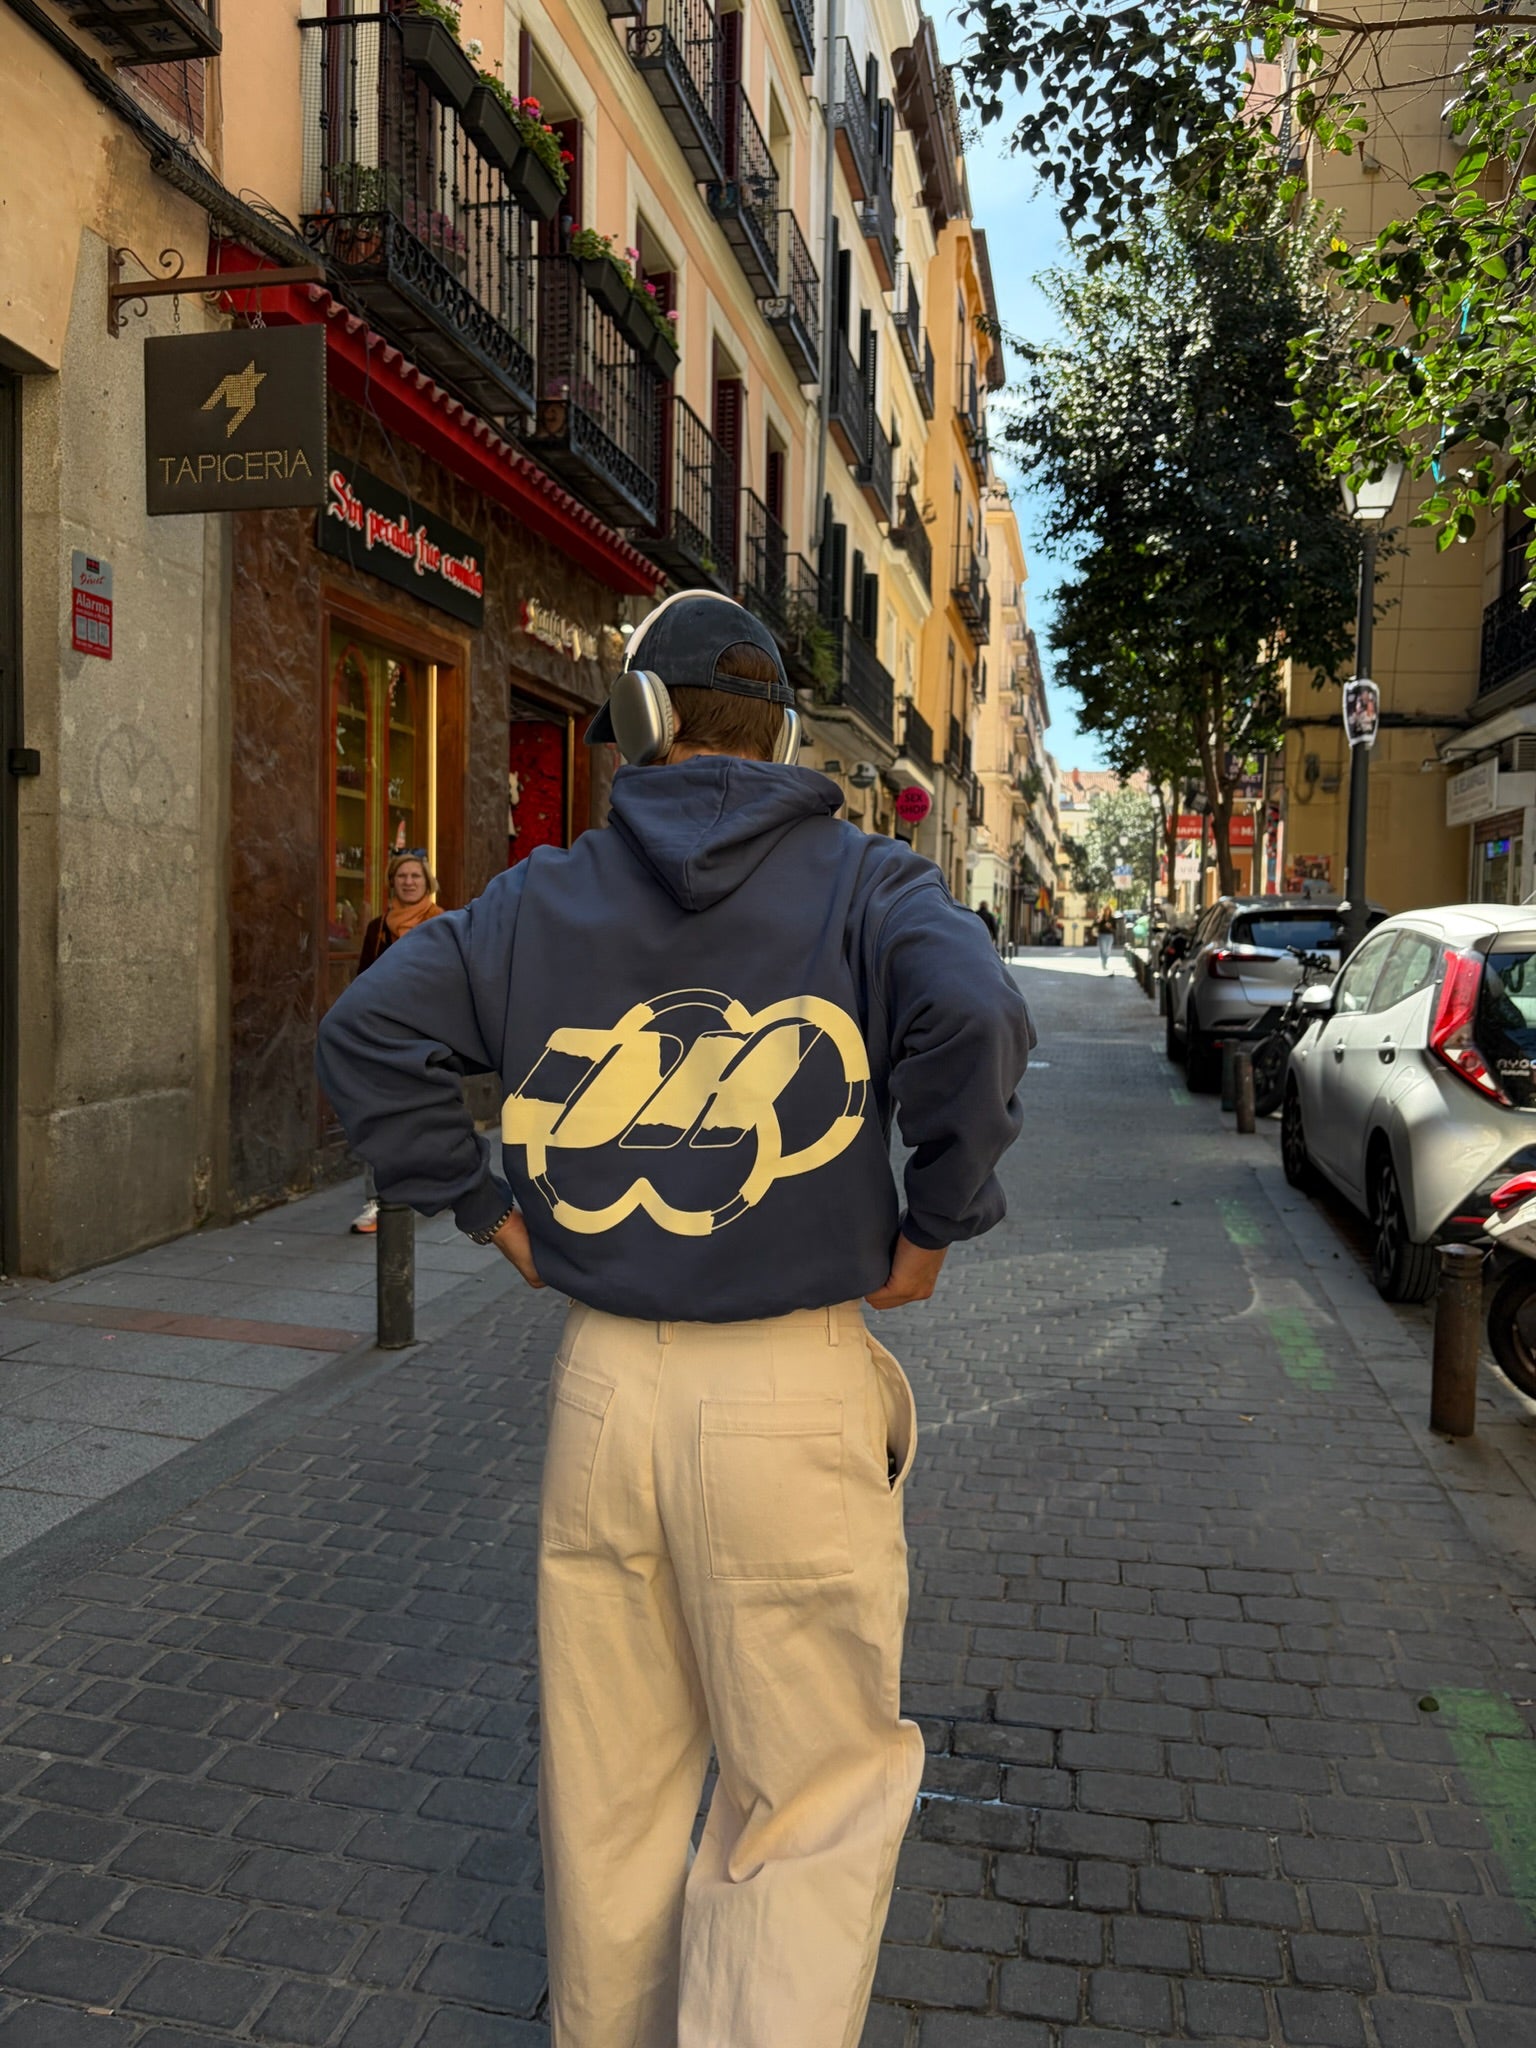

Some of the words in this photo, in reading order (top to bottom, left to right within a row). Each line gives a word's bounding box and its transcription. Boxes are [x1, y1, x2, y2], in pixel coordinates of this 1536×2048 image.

[158, 448, 313, 485] TAPICERIA
[327, 470, 364, 531] Sin
[76, 593, 110, 615] Alarma
[899, 804, 928, 814] SHOP
[904, 793, 922, 803] SEX
